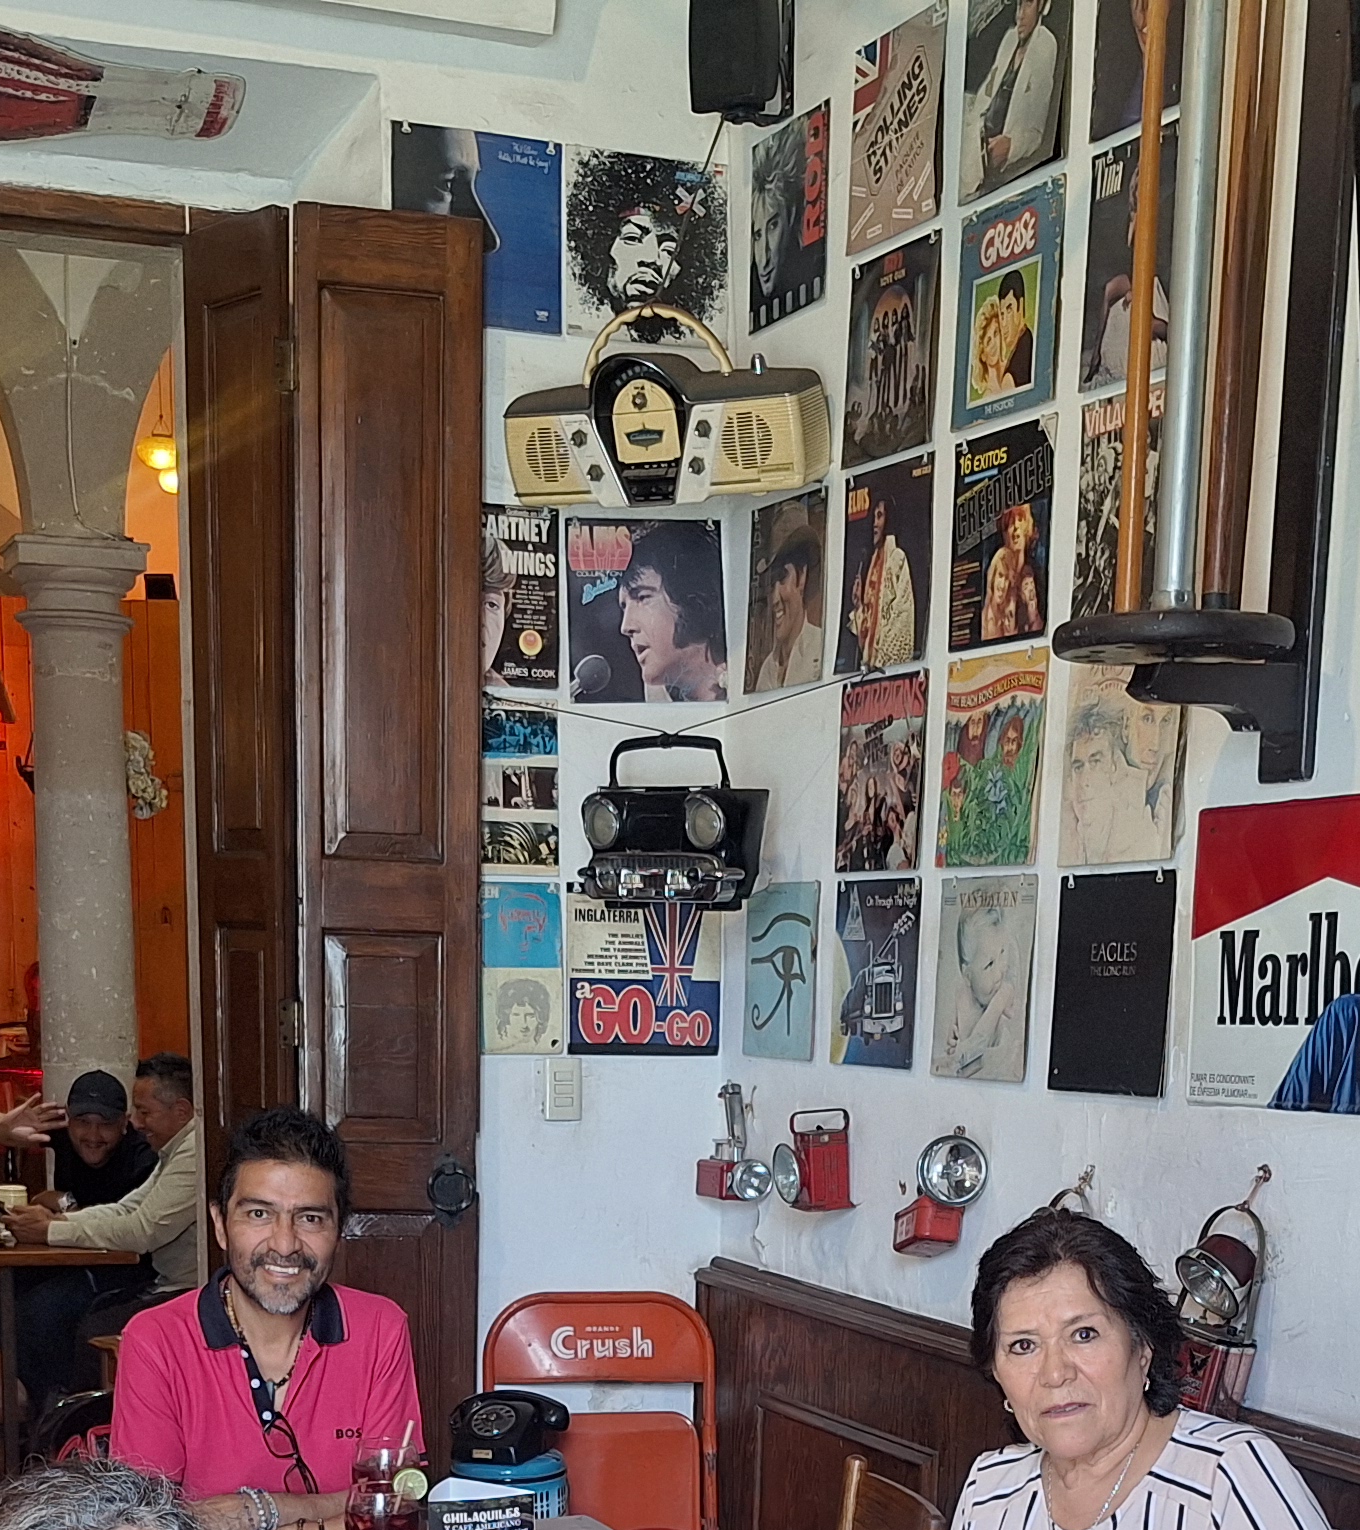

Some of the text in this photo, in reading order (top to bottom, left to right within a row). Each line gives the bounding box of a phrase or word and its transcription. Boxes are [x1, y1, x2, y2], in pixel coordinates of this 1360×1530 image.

[866, 55, 923, 165] ROLLING
[802, 111, 824, 246] ROD
[1094, 157, 1124, 202] Tina
[980, 210, 1037, 268] GREASE
[959, 453, 972, 476] 16
[973, 446, 1008, 471] EXITOS
[501, 550, 556, 578] WINGS
[531, 668, 556, 678] COOK
[574, 908, 640, 924] INGLATERRA
[1091, 941, 1138, 962] EAGLES
[1103, 965, 1121, 976] LONG
[575, 981, 594, 999] a
[550, 1325, 654, 1360] Crush
[335, 1427, 362, 1440] BOS
[442, 1506, 521, 1524] CHILAQUILES
[475, 1519, 521, 1530] AMERICANO
